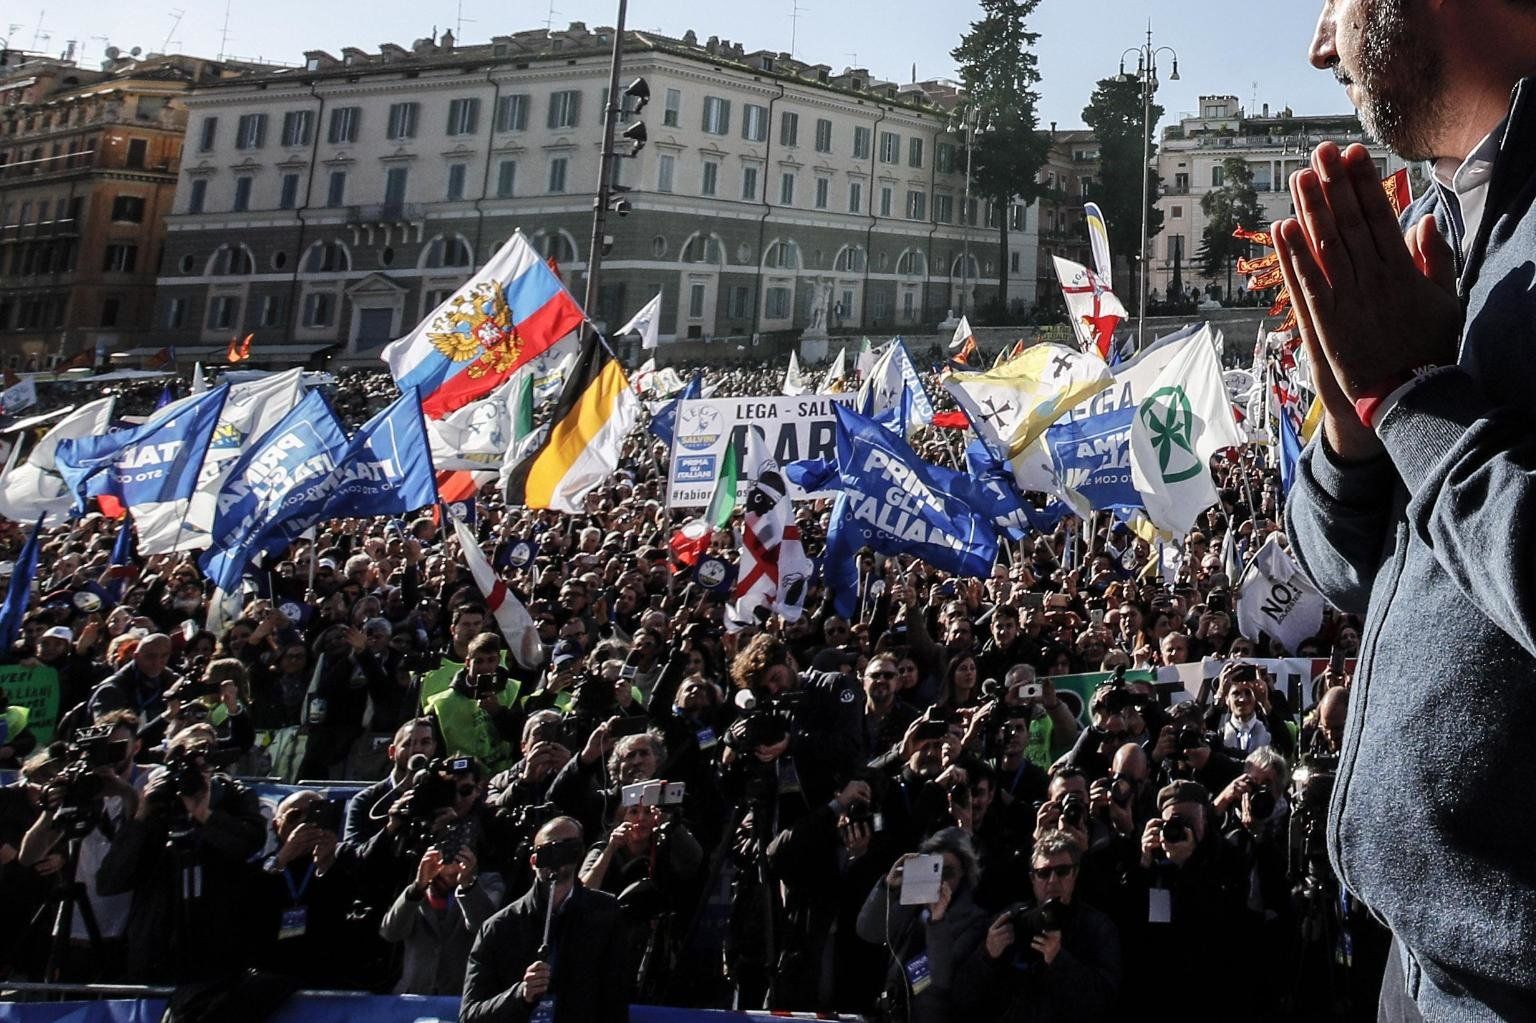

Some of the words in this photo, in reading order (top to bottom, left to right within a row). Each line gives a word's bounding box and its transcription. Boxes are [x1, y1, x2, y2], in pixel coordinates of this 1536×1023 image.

[682, 405, 718, 424] LEGA
[736, 404, 778, 419] LEGA
[864, 449, 945, 512] PRIMA
[886, 487, 923, 517] GLI
